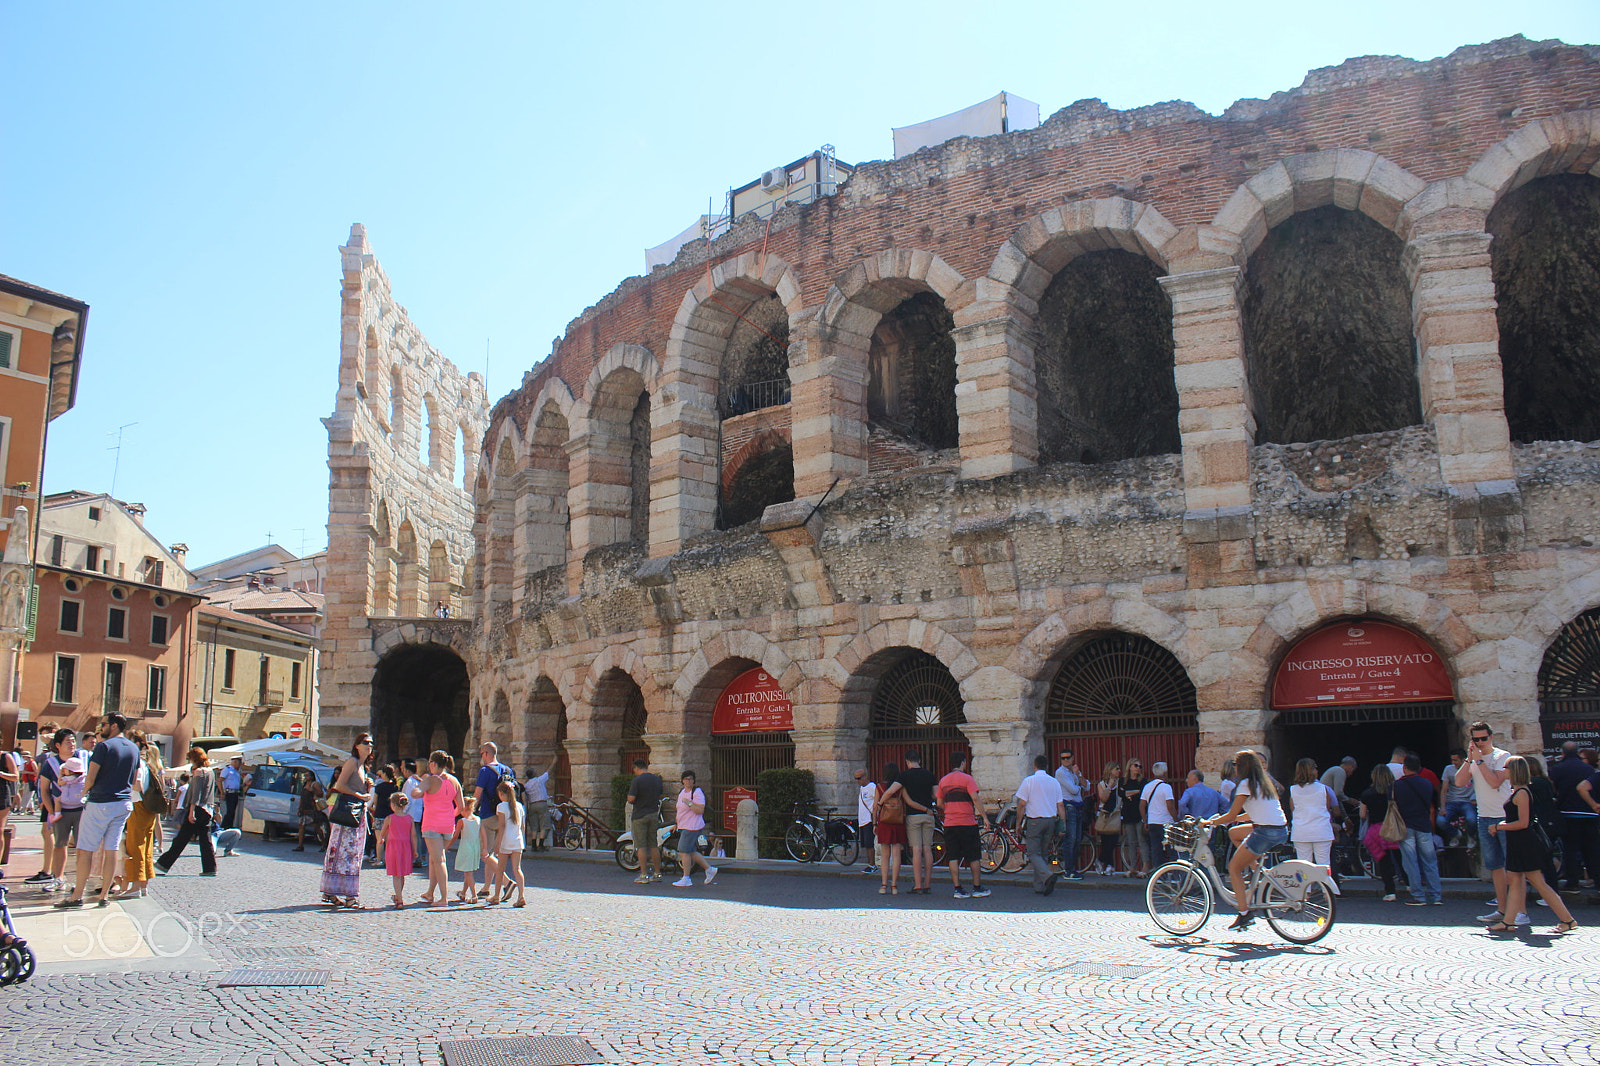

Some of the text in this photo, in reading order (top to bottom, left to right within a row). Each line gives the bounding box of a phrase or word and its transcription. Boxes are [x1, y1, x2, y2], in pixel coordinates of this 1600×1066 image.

[1287, 653, 1433, 672] INGRESSO RISERVATO
[1320, 671, 1356, 681] Entrata
[1368, 670, 1392, 678] Gate
[1393, 667, 1401, 677] 4
[736, 706, 760, 715] Entrata
[768, 704, 785, 713] Gate
[1554, 721, 1600, 730] ANFITEA
